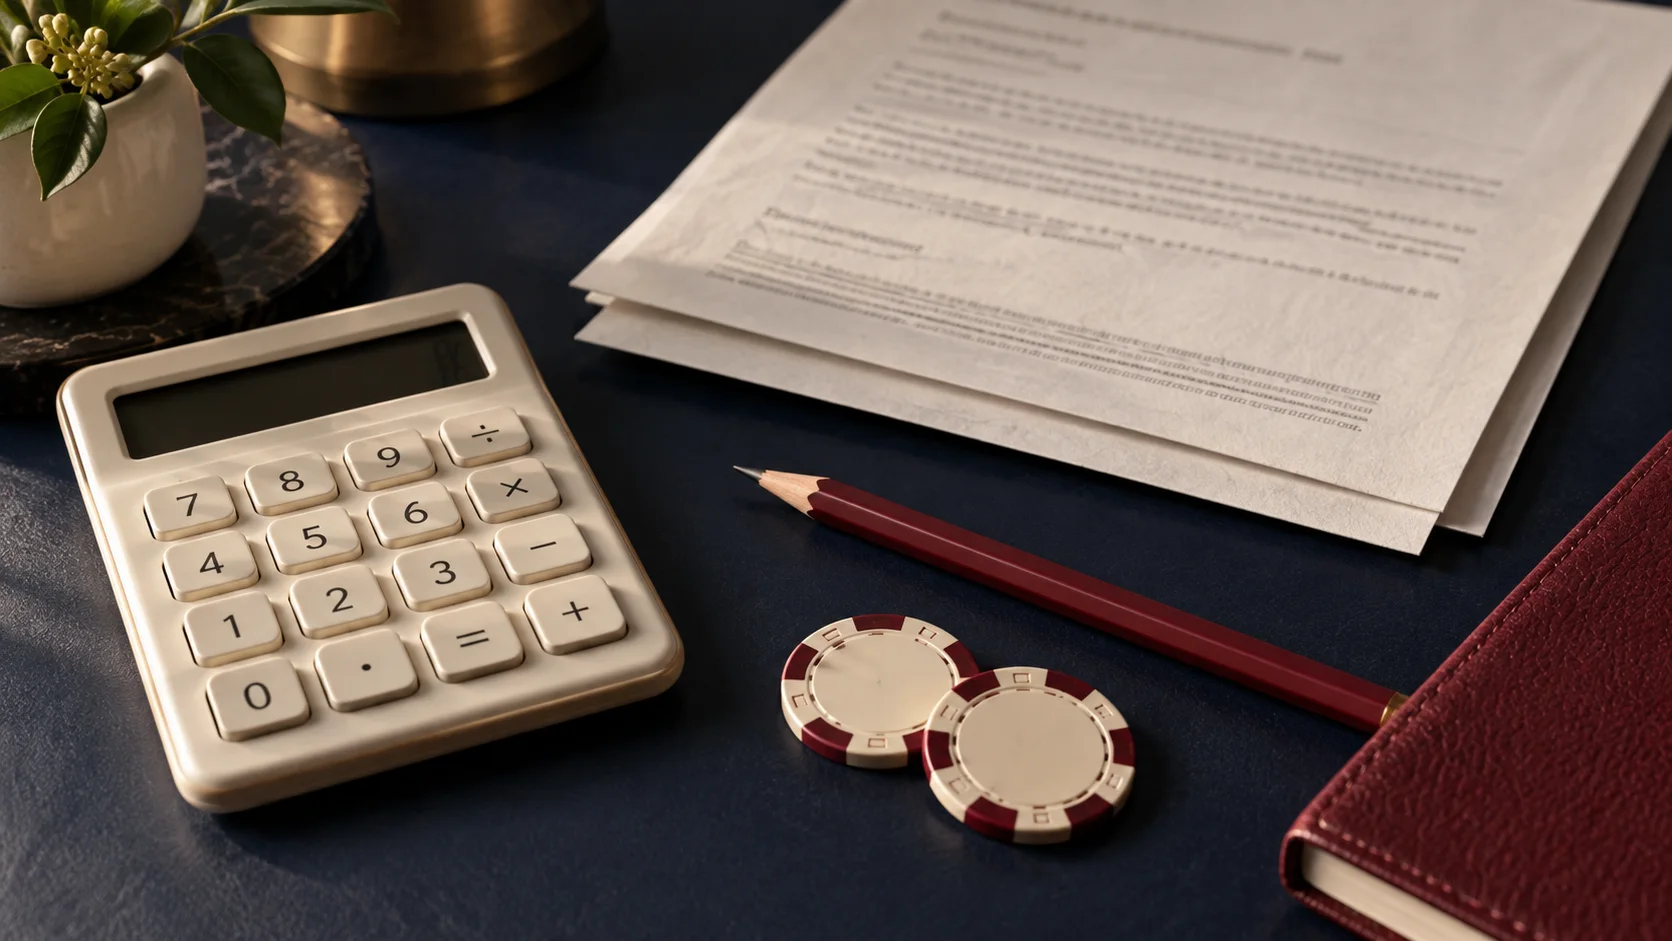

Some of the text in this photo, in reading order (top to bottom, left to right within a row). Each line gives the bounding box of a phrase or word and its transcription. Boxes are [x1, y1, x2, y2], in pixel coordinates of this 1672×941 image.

[376, 446, 402, 470] 9
[278, 470, 304, 493] 8
[176, 493, 199, 517] 7
[404, 501, 430, 525] 6
[302, 525, 328, 550] 5
[199, 551, 225, 575] 4
[429, 560, 457, 586] 3
[325, 587, 354, 614] 2
[223, 614, 241, 640] 1
[243, 681, 272, 711] 0
